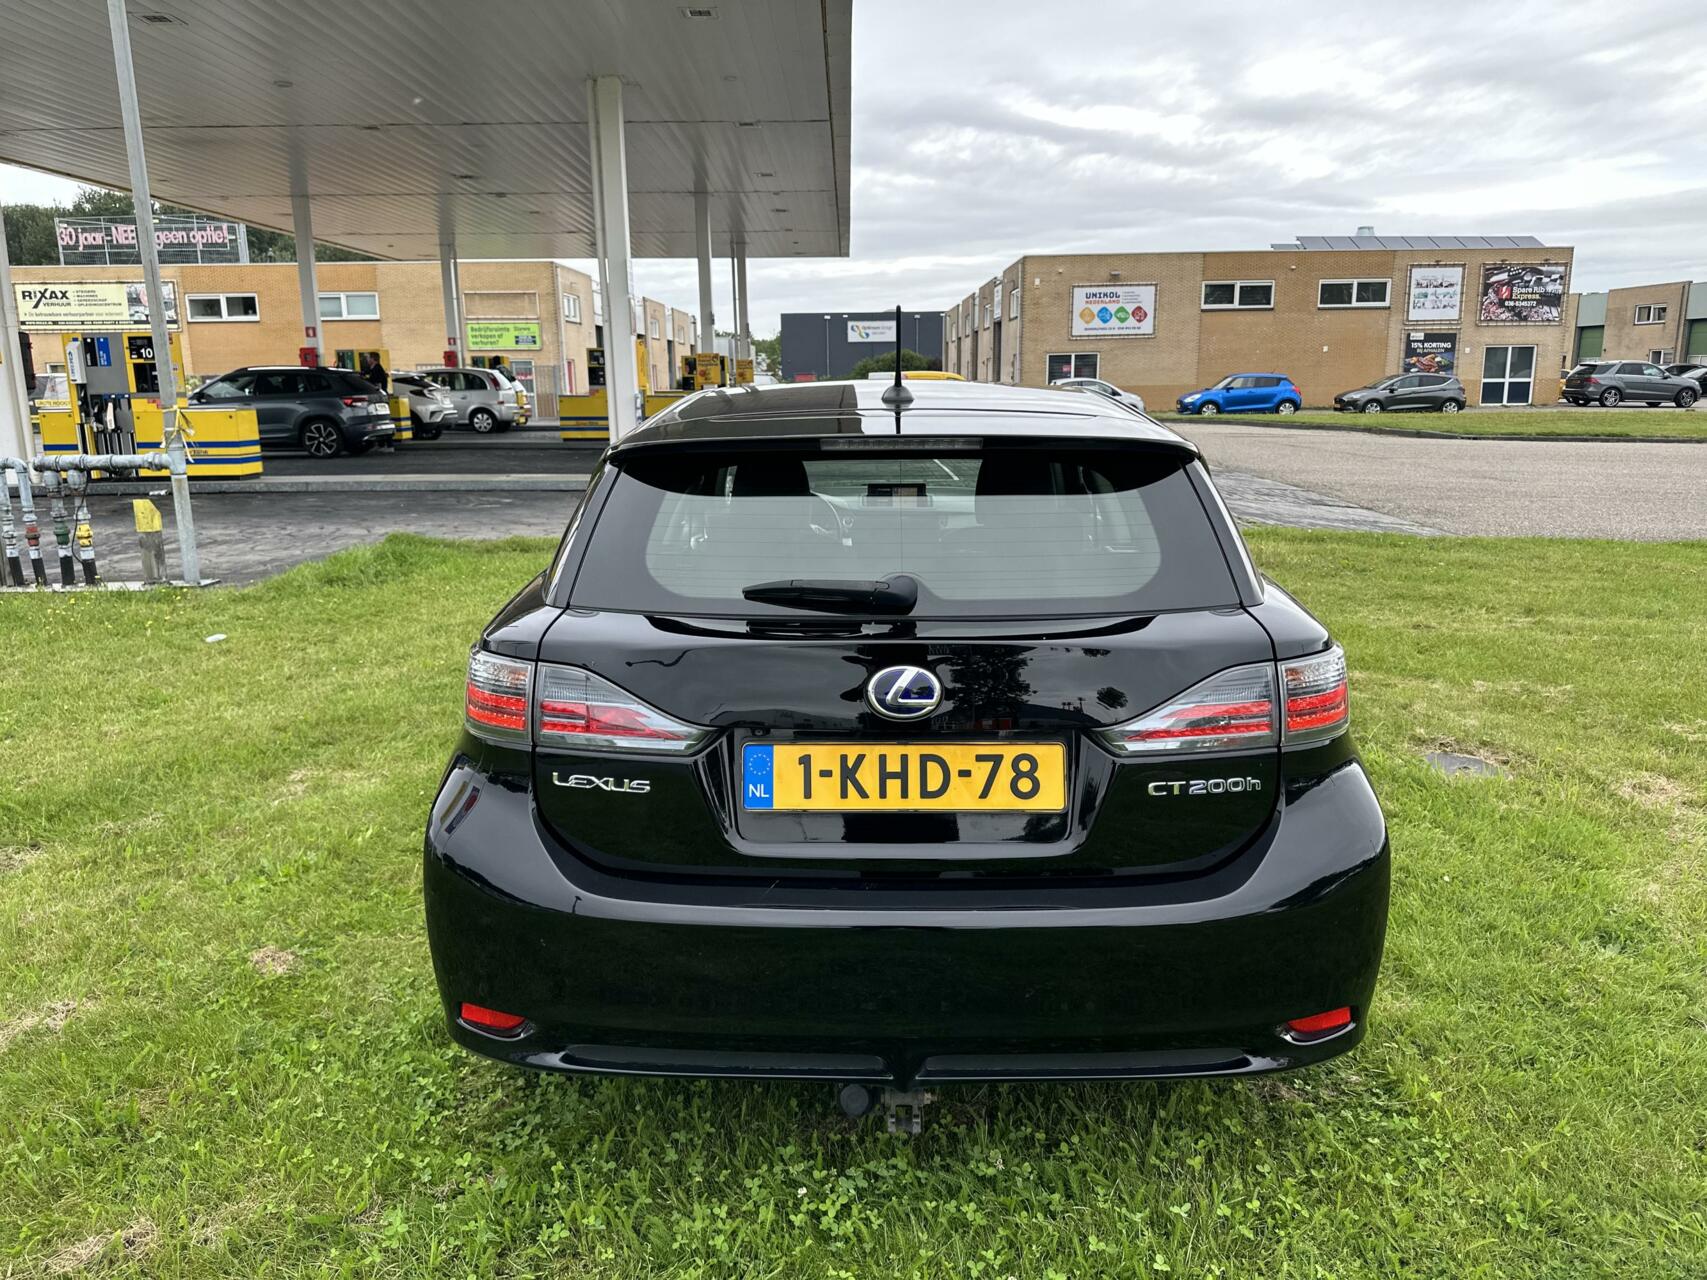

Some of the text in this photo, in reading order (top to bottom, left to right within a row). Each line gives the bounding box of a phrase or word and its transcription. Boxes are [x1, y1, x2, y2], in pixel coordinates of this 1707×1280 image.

[60, 228, 76, 245] 30
[111, 225, 136, 244] NEE
[155, 231, 187, 249] geen
[190, 224, 228, 249] optie!
[1085, 291, 1121, 299] UNIKOL
[140, 348, 153, 358] 10
[552, 772, 651, 793] LEXUS
[748, 752, 1041, 801] NL 1-KHD-78
[1147, 777, 1261, 796] CT200h
